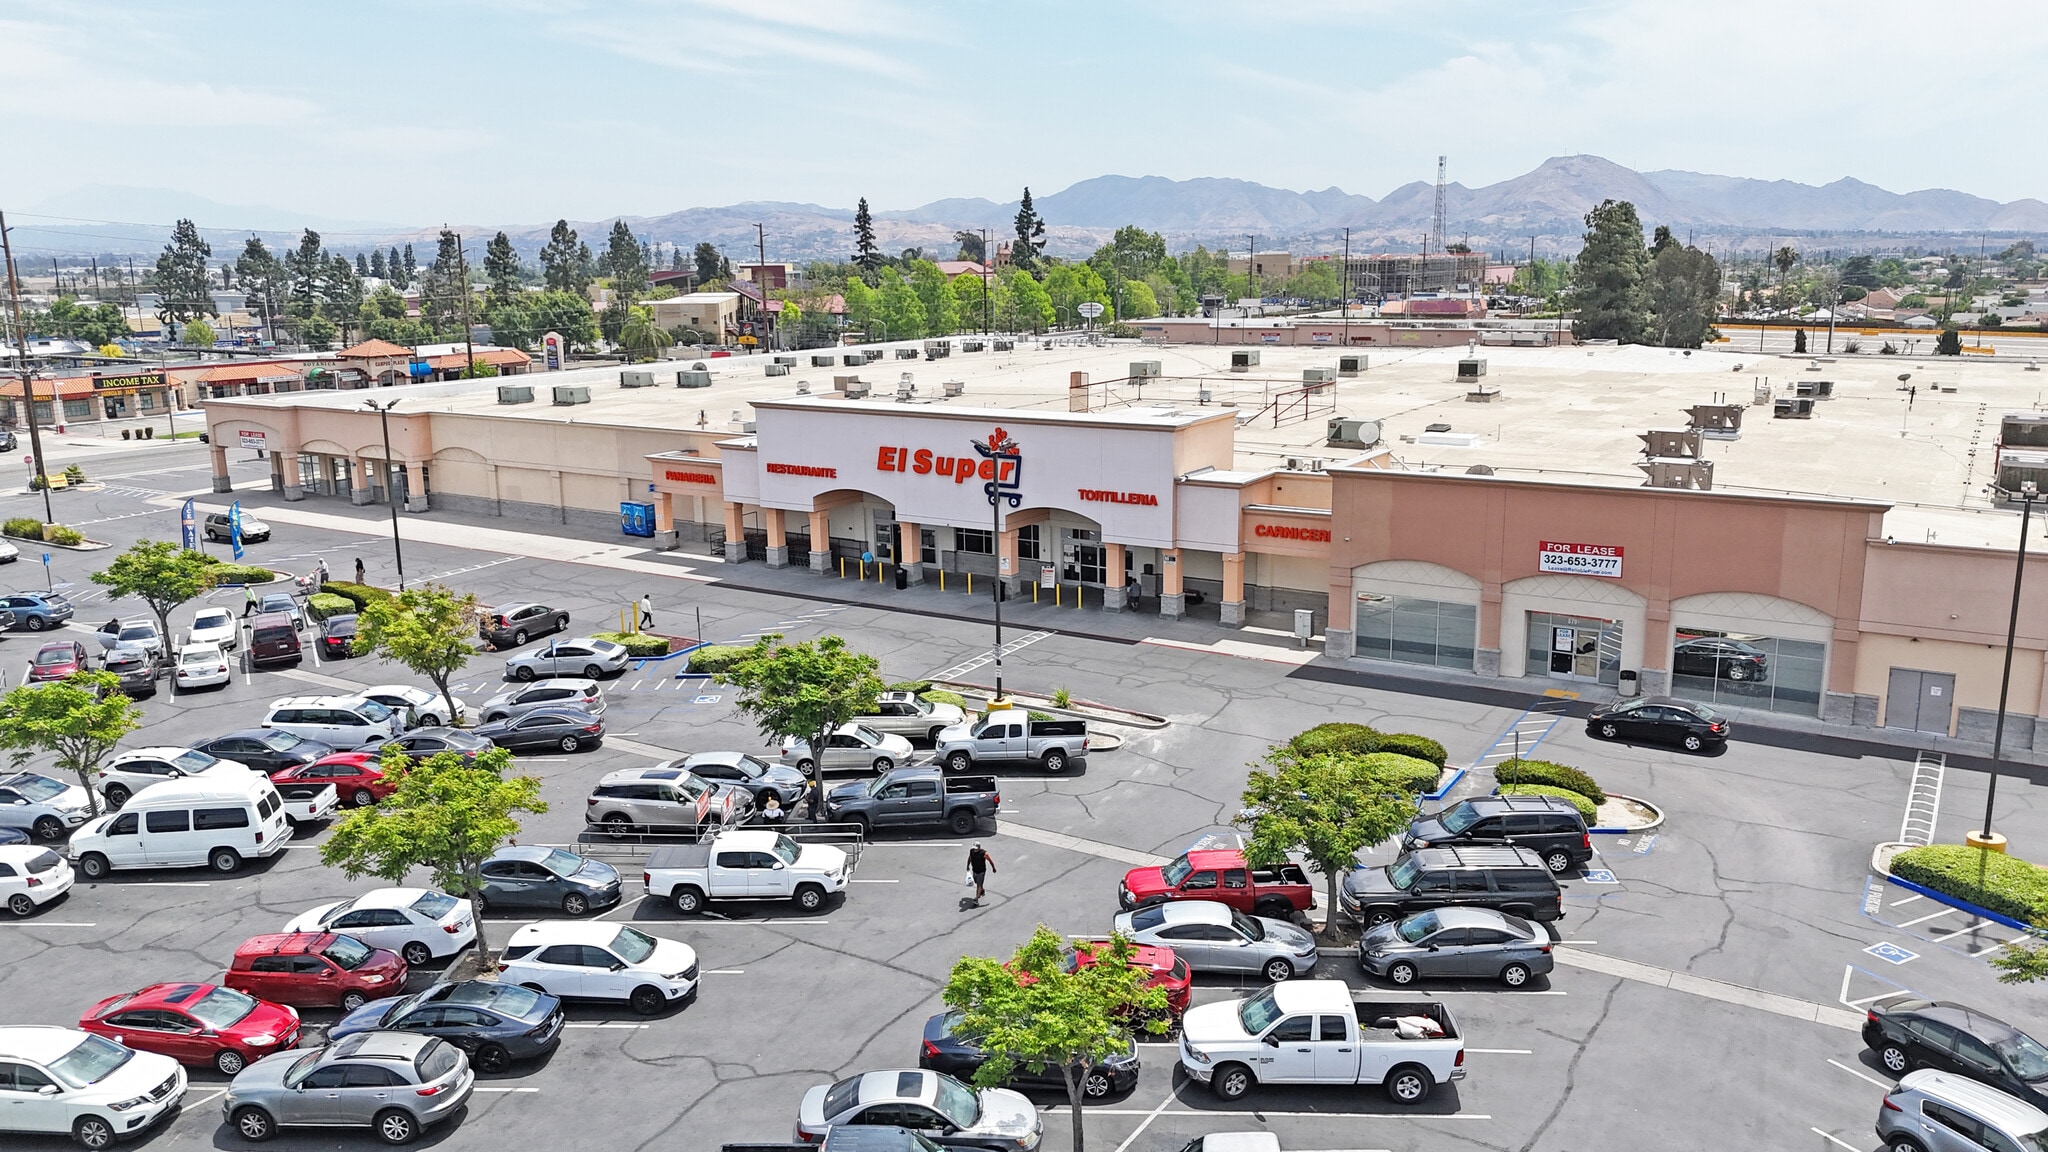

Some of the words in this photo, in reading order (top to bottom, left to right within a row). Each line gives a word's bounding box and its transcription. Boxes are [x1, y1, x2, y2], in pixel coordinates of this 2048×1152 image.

[103, 377, 140, 387] INCOME
[141, 376, 160, 385] TAX
[766, 463, 838, 479] RESTAURANTE
[877, 446, 907, 472] El
[912, 448, 1015, 484] Super
[665, 471, 717, 485] PANADERIA
[1078, 488, 1159, 506] TORTILLERIA
[1255, 524, 1332, 543] CARNICERI
[1547, 542, 1571, 553] FOR
[1577, 545, 1616, 556] LEASE
[1544, 554, 1618, 569] 323-653-3777
[1864, 890, 1883, 914] PARKING
